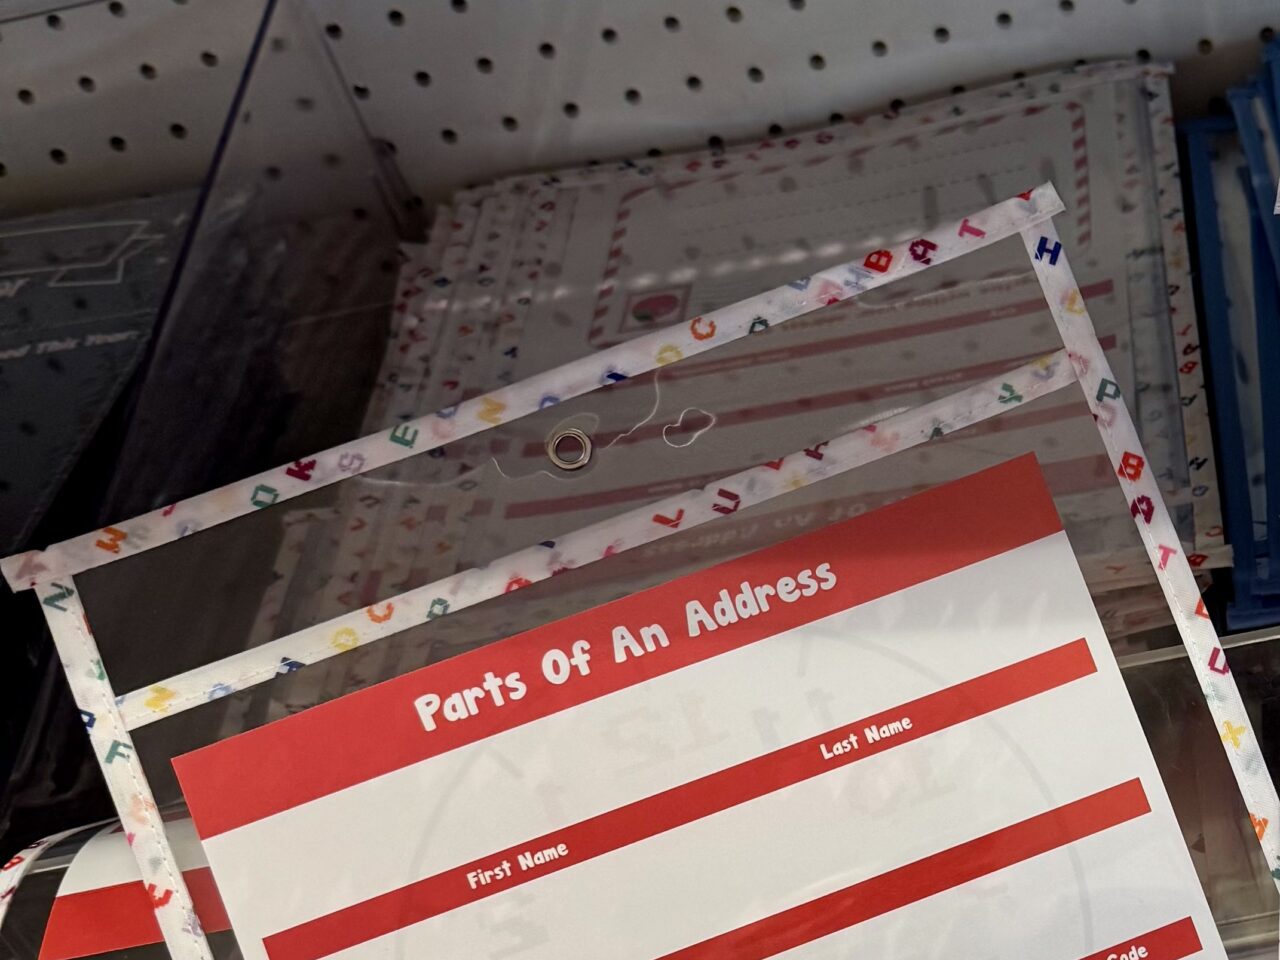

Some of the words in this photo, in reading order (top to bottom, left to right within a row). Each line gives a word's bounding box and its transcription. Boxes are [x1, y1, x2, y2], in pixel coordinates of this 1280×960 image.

[413, 672, 527, 733] Parts
[543, 646, 592, 686] Of
[613, 622, 670, 665] An
[685, 562, 838, 637] Address
[820, 734, 861, 760] Last
[865, 715, 914, 749] Name
[467, 859, 512, 890] First
[518, 840, 569, 874] Name
